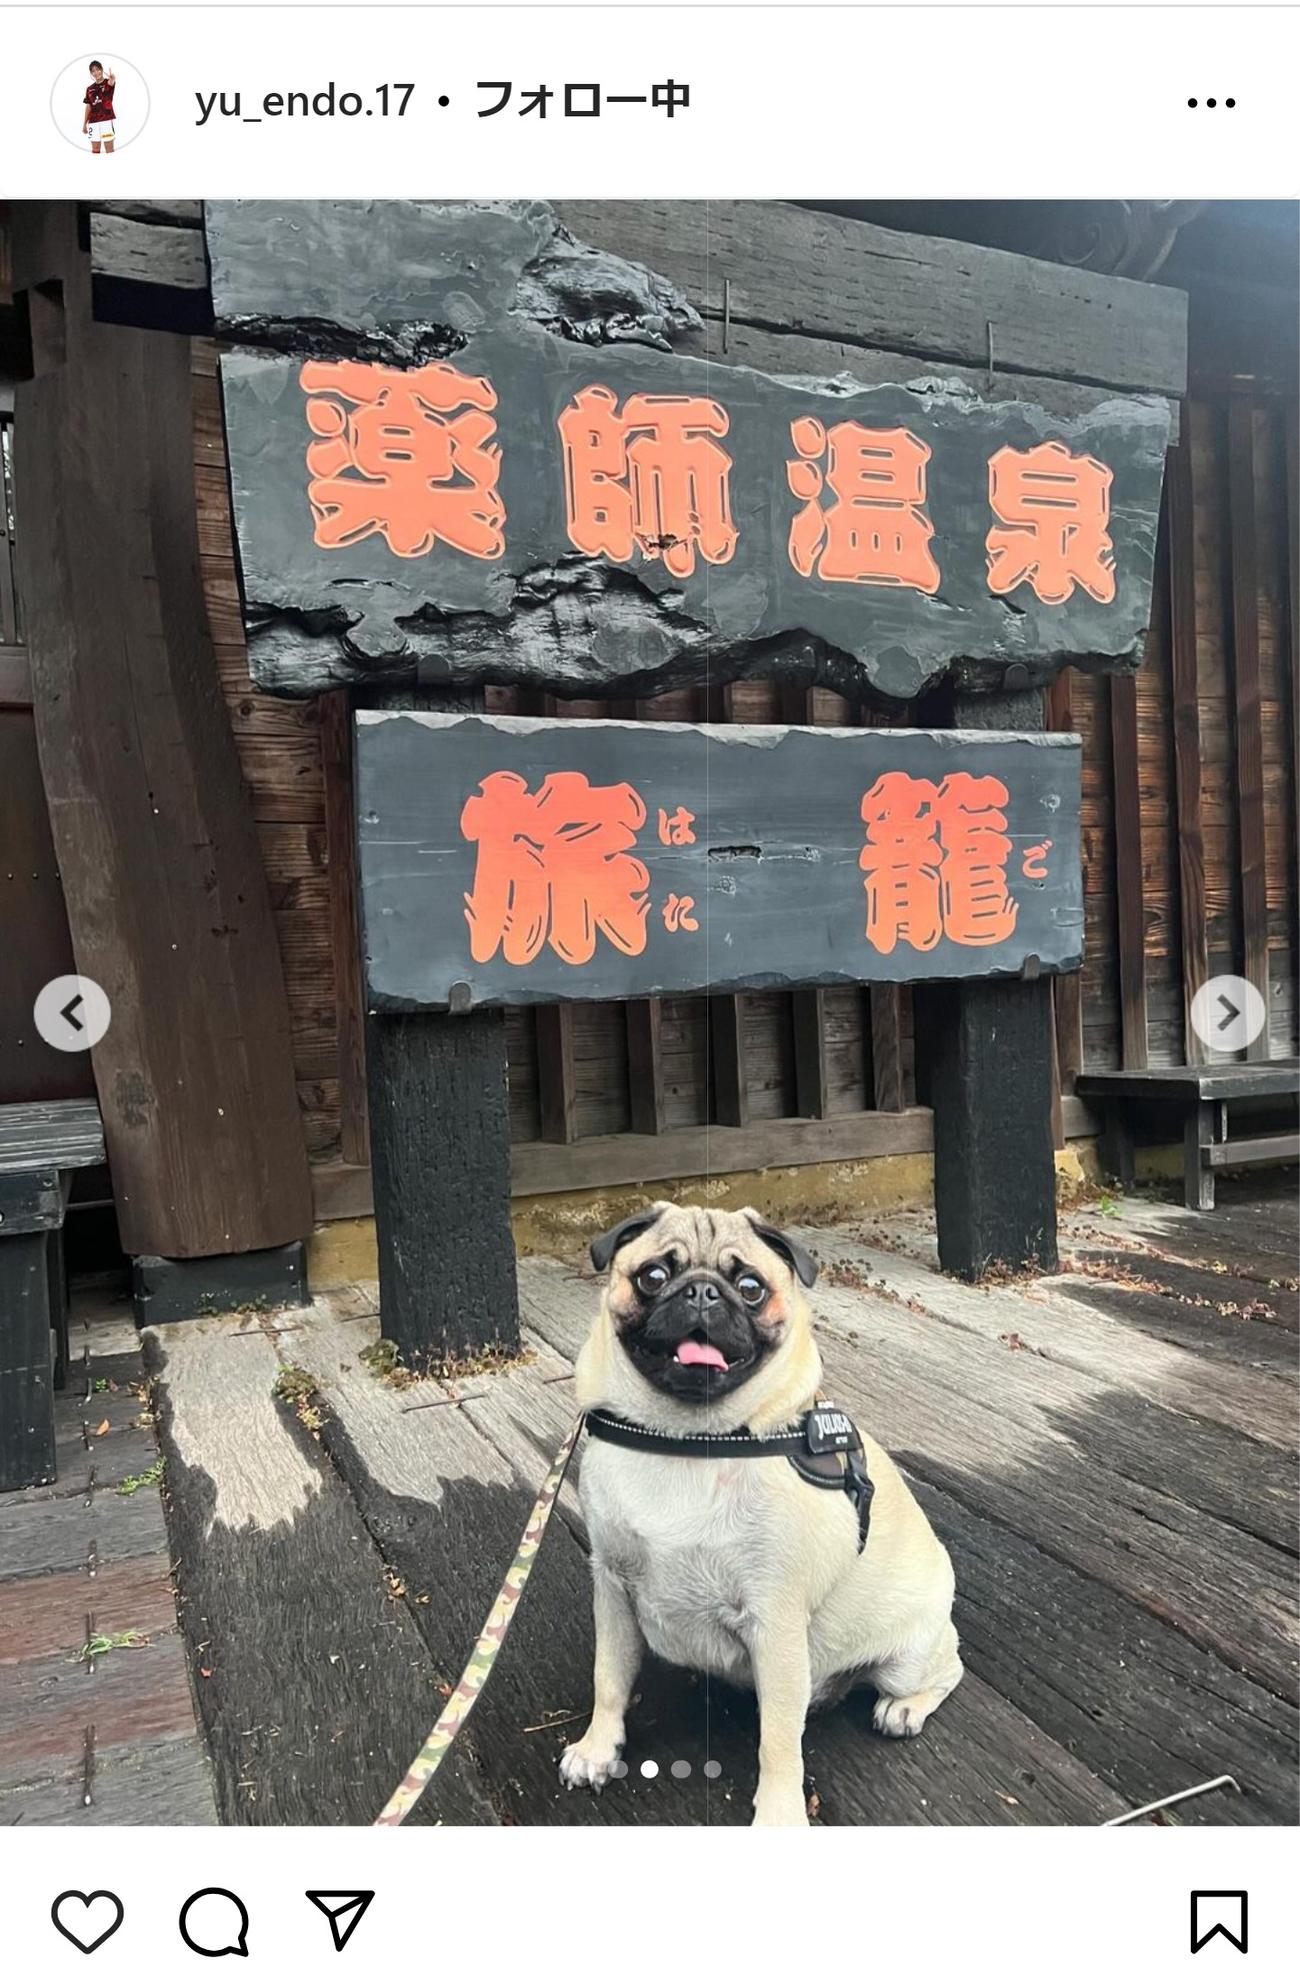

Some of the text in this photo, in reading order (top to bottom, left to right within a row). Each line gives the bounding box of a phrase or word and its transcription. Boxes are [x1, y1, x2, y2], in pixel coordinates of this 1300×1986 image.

[300, 360, 1117, 605] 薬師温泉
[1022, 838, 1053, 879] ご
